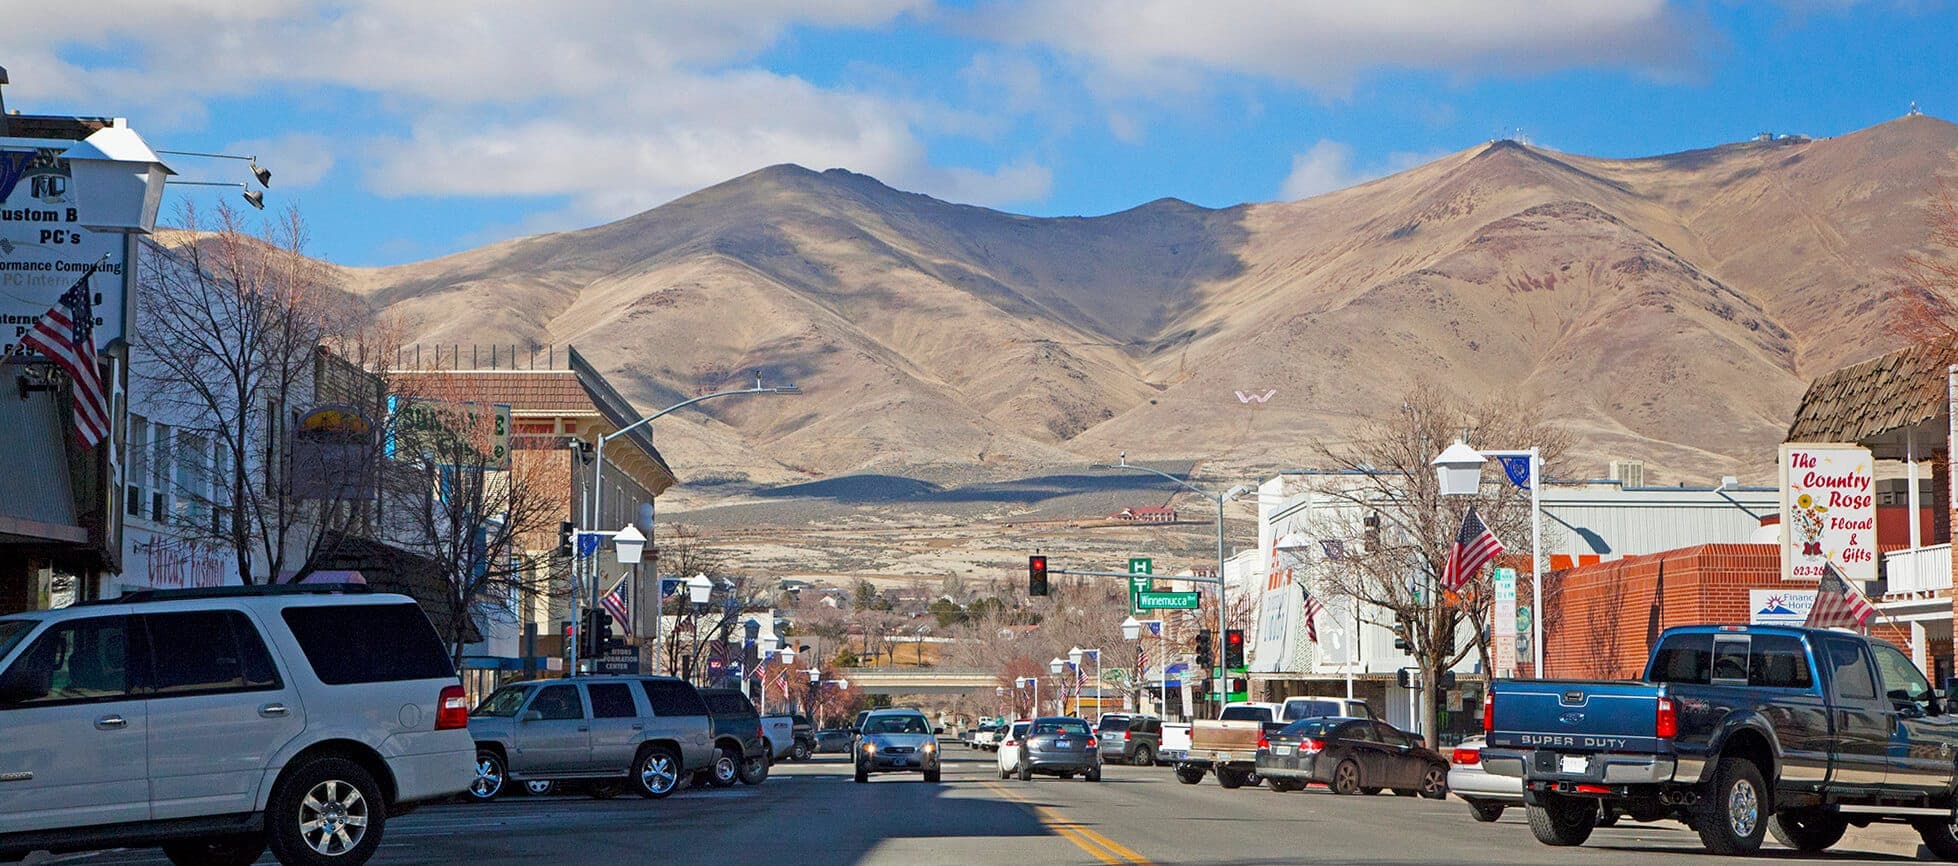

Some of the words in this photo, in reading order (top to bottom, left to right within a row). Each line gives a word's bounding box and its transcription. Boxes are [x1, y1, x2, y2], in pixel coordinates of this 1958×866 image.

[0, 208, 59, 221] ustom
[40, 230, 81, 244] PC's
[0, 261, 52, 272] ormance
[1792, 453, 1817, 468] The
[1803, 472, 1871, 492] Country
[1829, 491, 1872, 510] Rose
[1831, 517, 1873, 530] Floral
[1849, 533, 1858, 546] &
[1842, 548, 1872, 563] Gifts
[1793, 566, 1827, 576] 623-26
[1141, 596, 1187, 606] Winnemucca
[1789, 601, 1812, 609] Horiz
[1521, 735, 1574, 745] SUPER
[1584, 738, 1626, 748] DUTY
